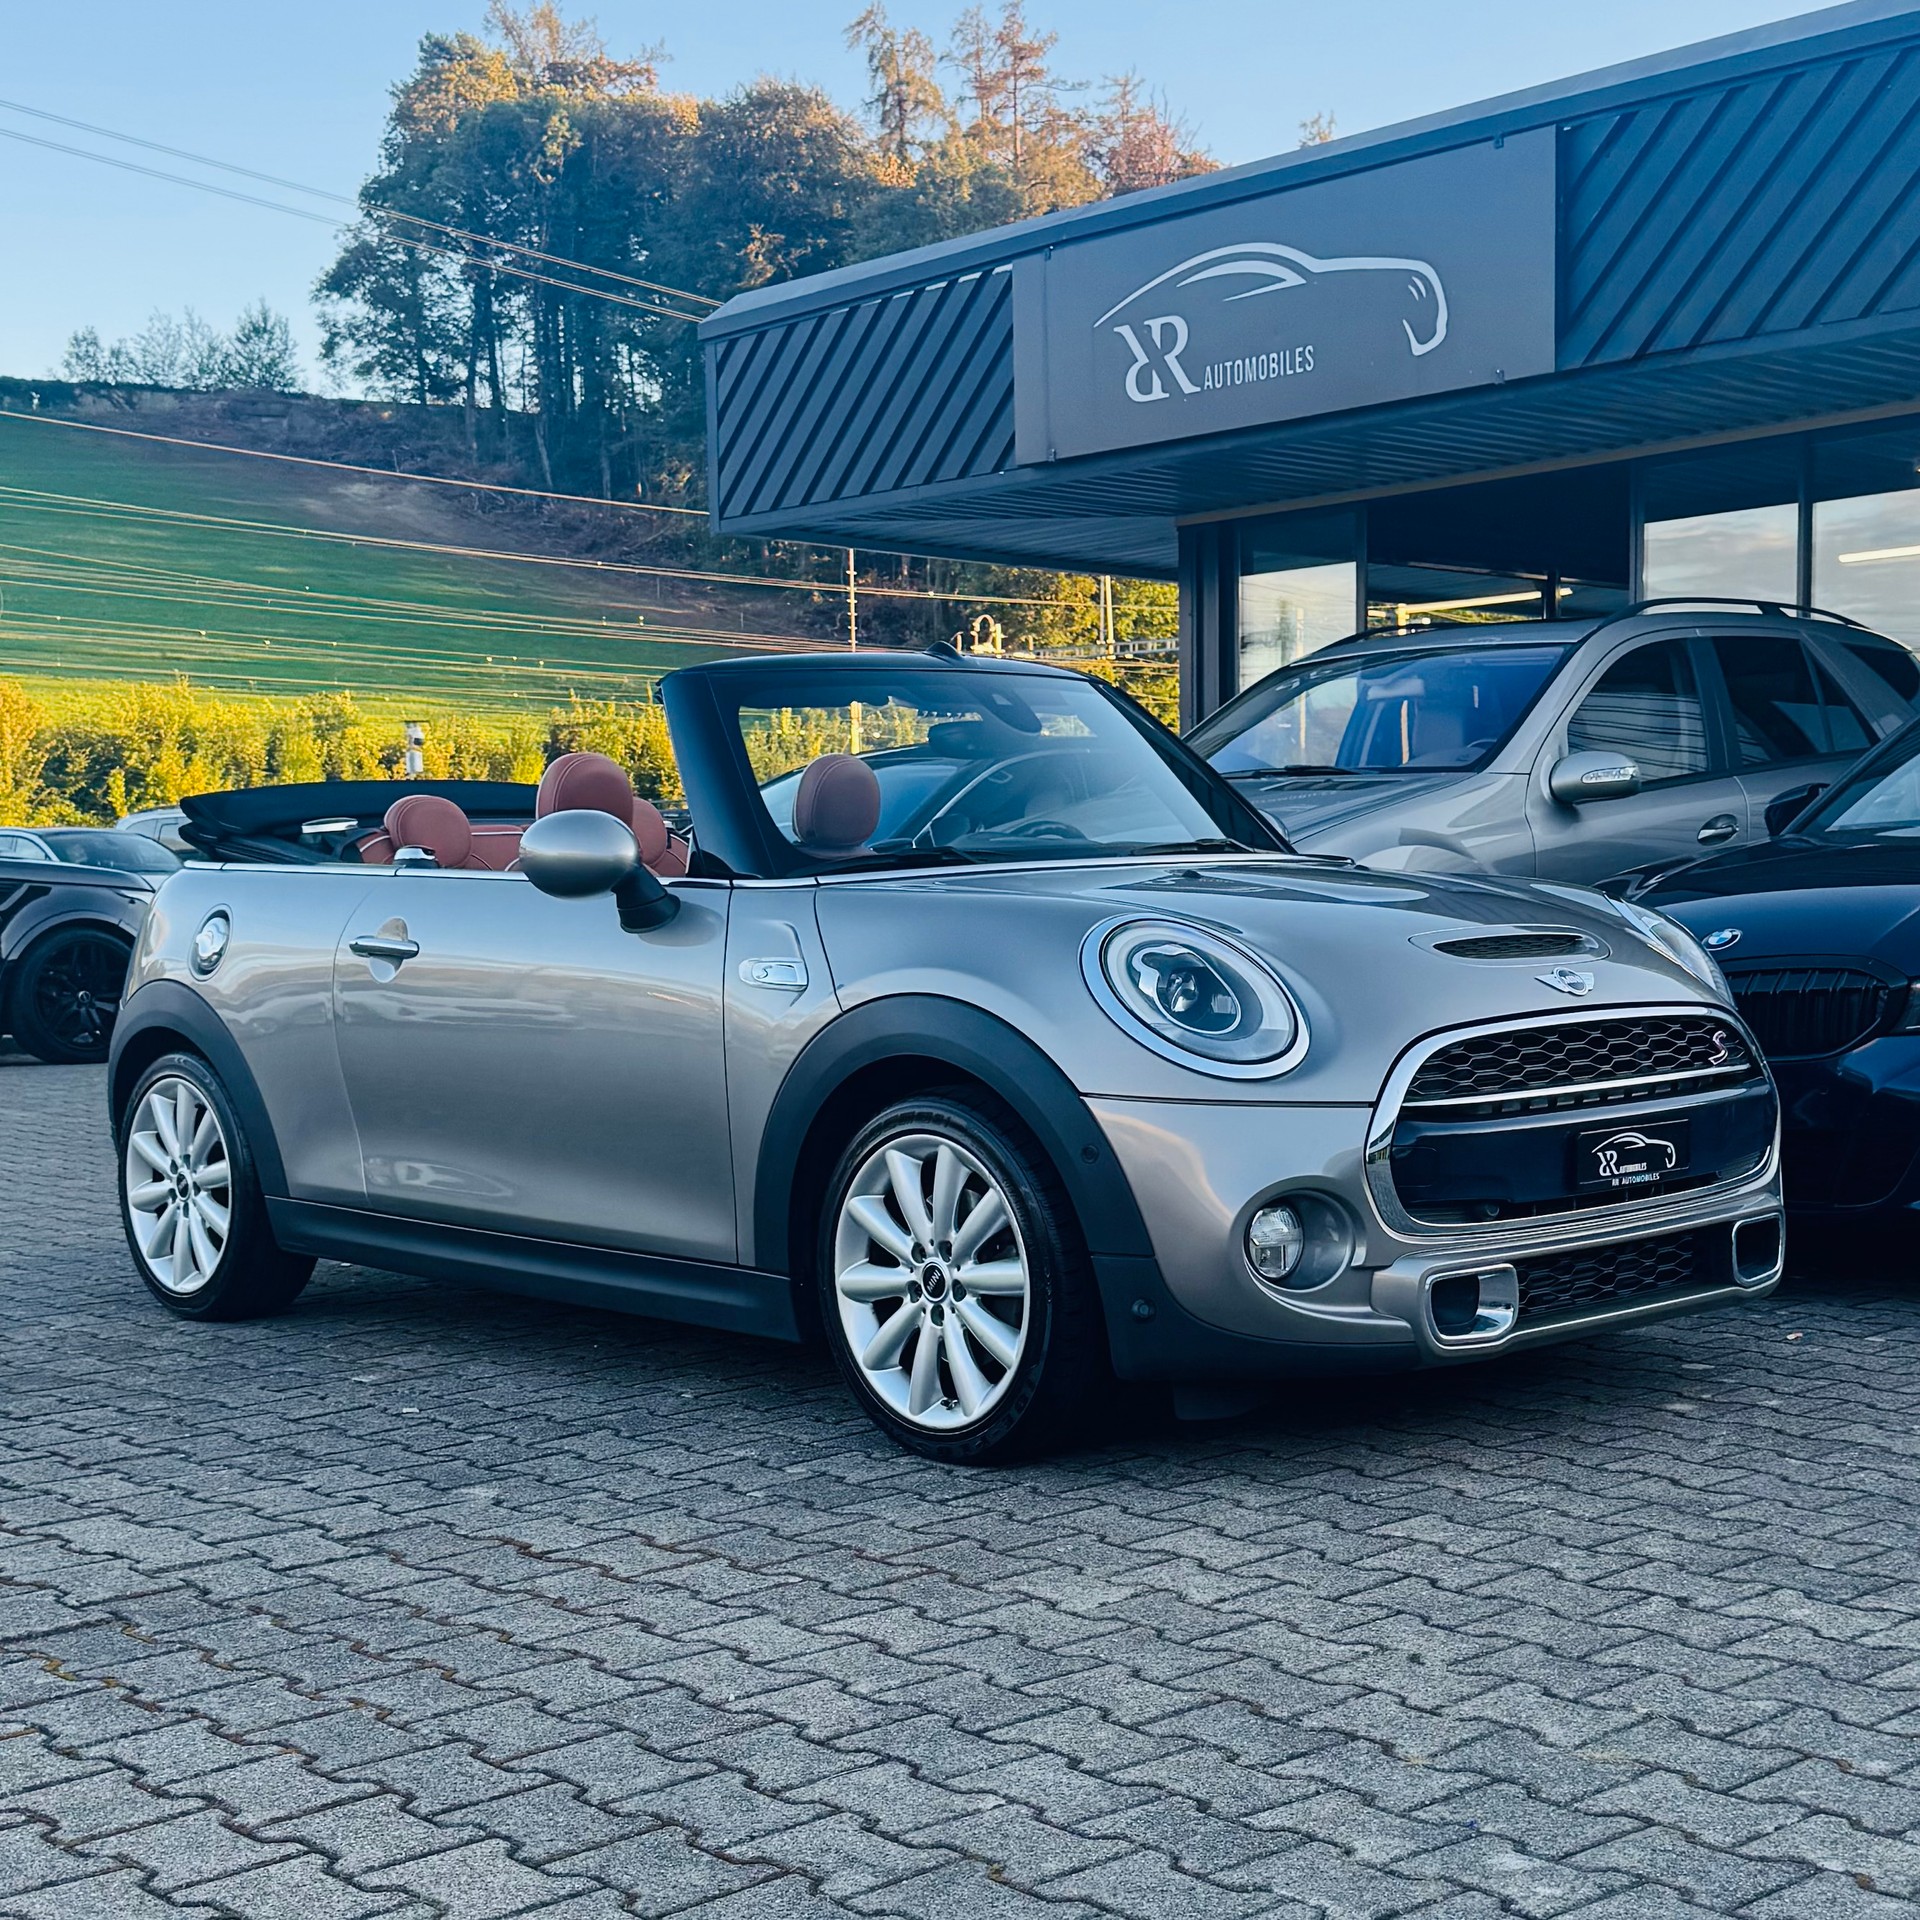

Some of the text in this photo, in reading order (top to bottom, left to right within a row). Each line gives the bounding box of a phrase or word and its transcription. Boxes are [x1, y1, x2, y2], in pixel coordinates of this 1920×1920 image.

[1203, 345, 1315, 390] AUTOMOBILES
[1707, 1030, 1729, 1066] S
[1621, 1172, 1660, 1185] AUTOMOBILES
[926, 1269, 941, 1293] MINI
